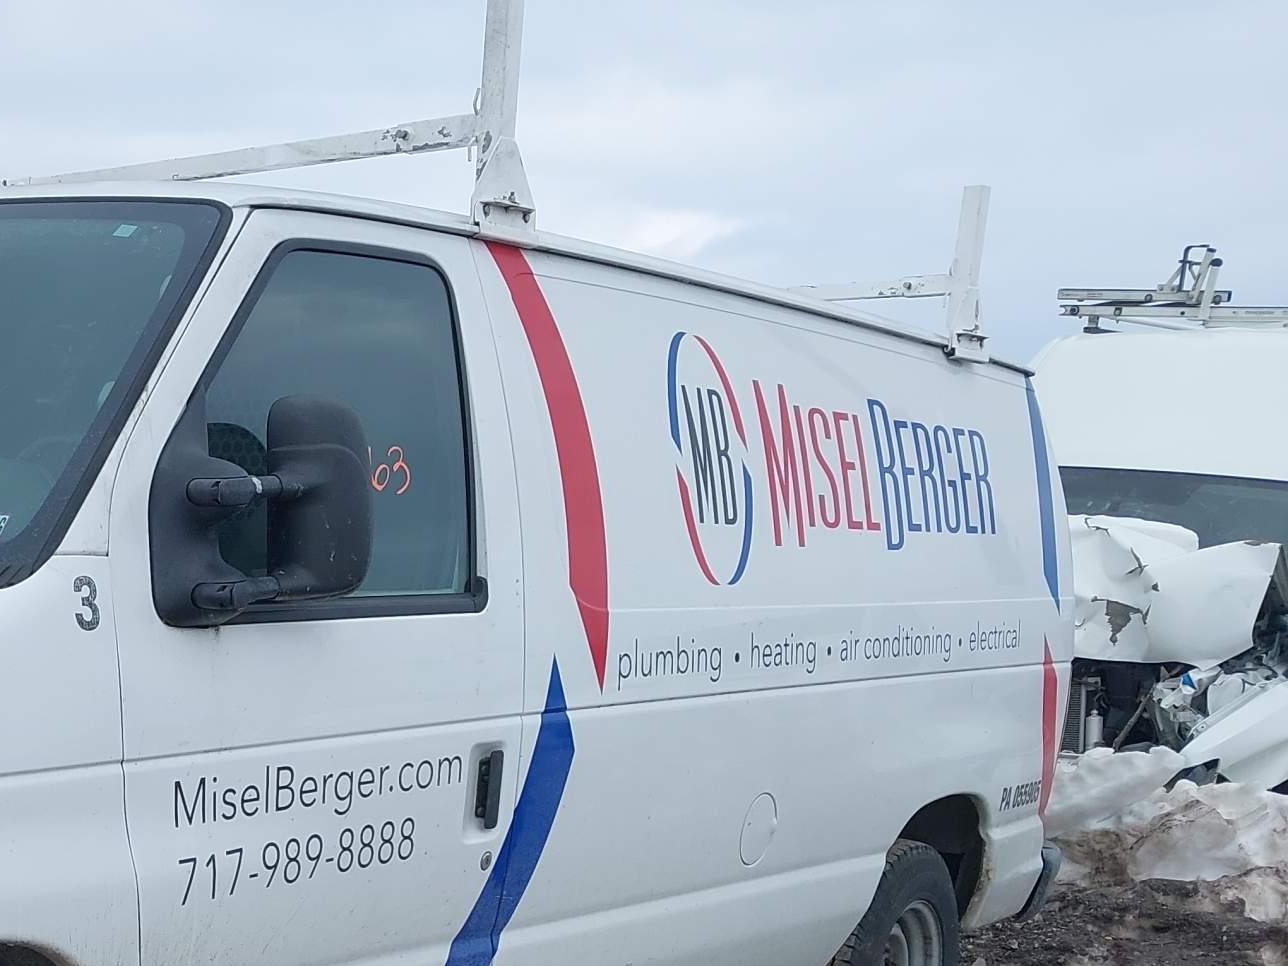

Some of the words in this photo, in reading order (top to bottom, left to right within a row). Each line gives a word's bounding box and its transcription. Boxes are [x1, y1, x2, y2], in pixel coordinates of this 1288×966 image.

[681, 384, 738, 526] MB
[73, 575, 100, 631] 3
[617, 638, 723, 690] plumbing
[749, 631, 818, 673] heating
[840, 632, 860, 661] air
[863, 625, 952, 662] conditioning
[968, 619, 1021, 652] electrical
[173, 753, 463, 829] MiselBerger.com
[999, 786, 1012, 812] PA
[178, 817, 416, 906] 717-989-8888
